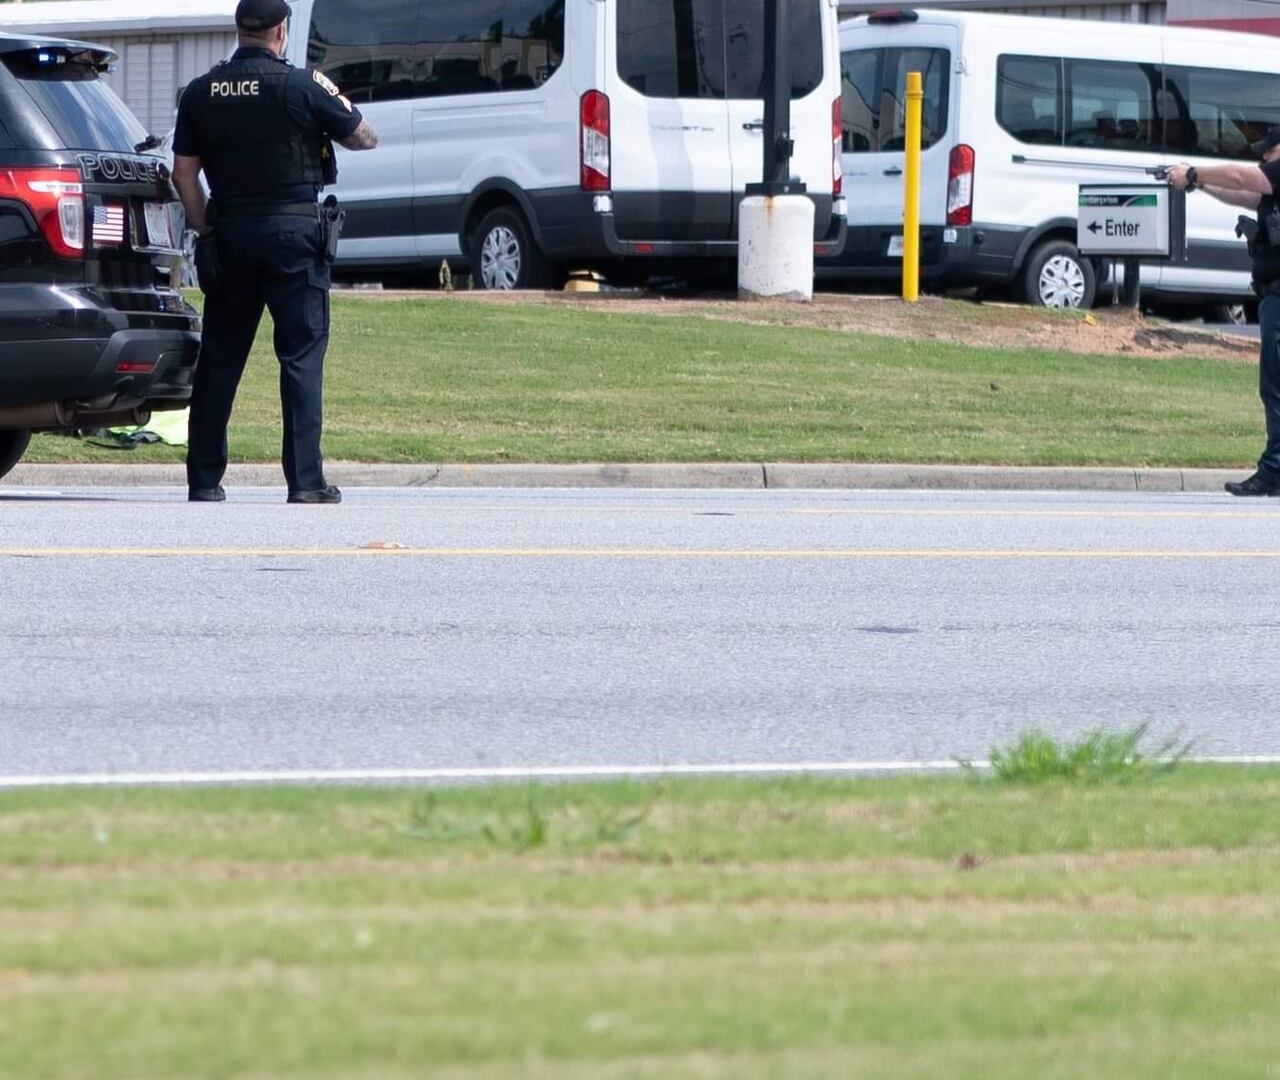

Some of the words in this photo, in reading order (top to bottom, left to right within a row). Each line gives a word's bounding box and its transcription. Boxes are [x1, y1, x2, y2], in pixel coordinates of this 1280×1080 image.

[210, 81, 260, 97] POLICE
[76, 153, 157, 182] POLICE
[1105, 219, 1140, 237] Enter
